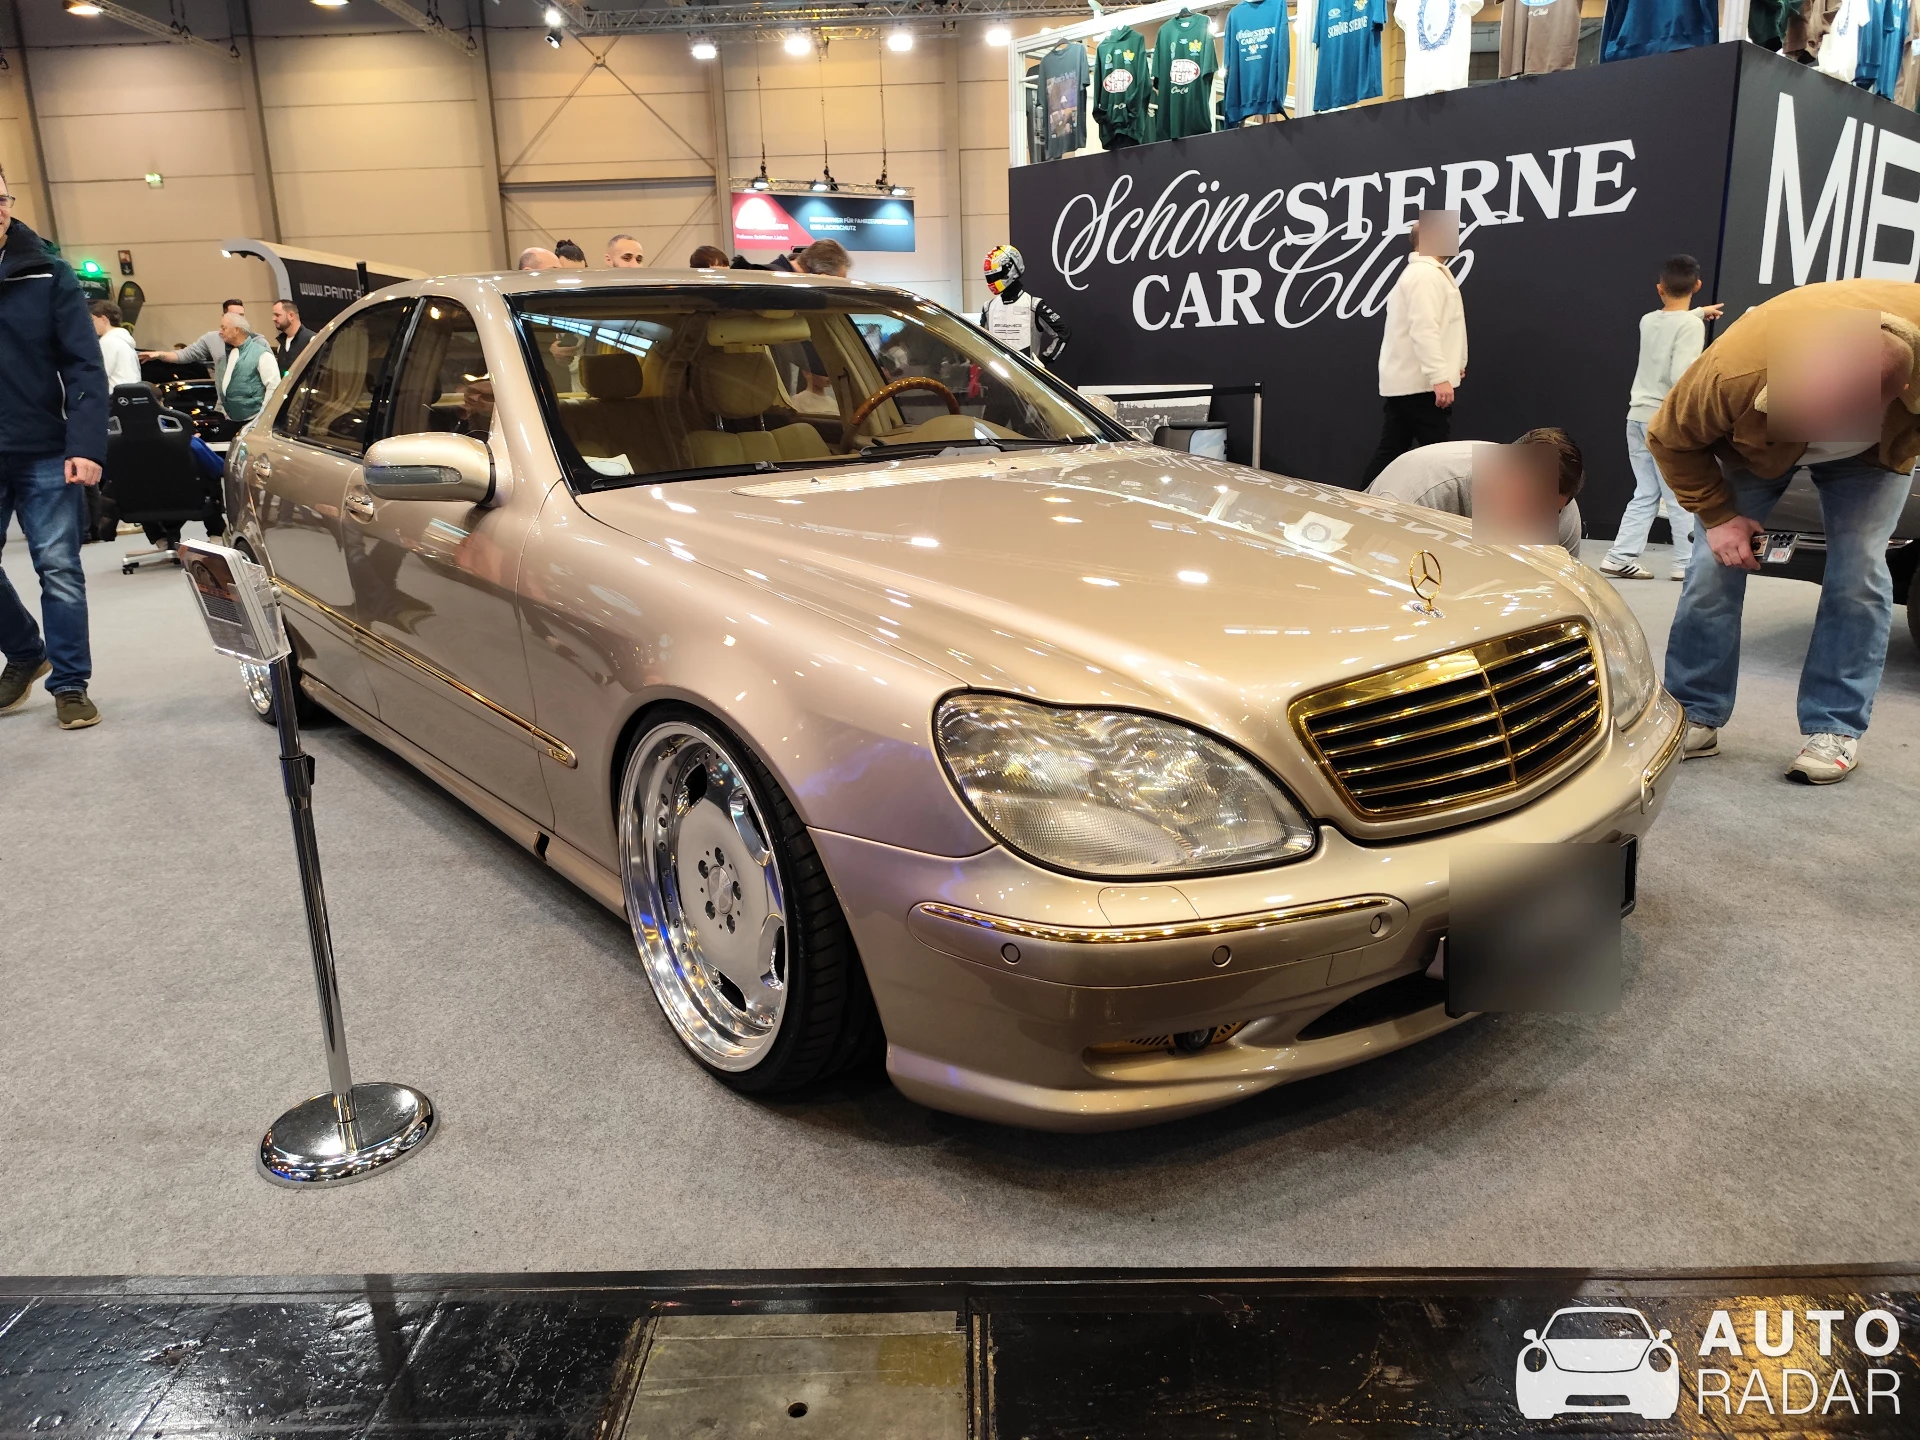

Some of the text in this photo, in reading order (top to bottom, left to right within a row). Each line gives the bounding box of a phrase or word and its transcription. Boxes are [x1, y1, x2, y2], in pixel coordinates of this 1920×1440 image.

[1052, 139, 1638, 290] Schöne STERNE
[1132, 267, 1266, 331] CAR
